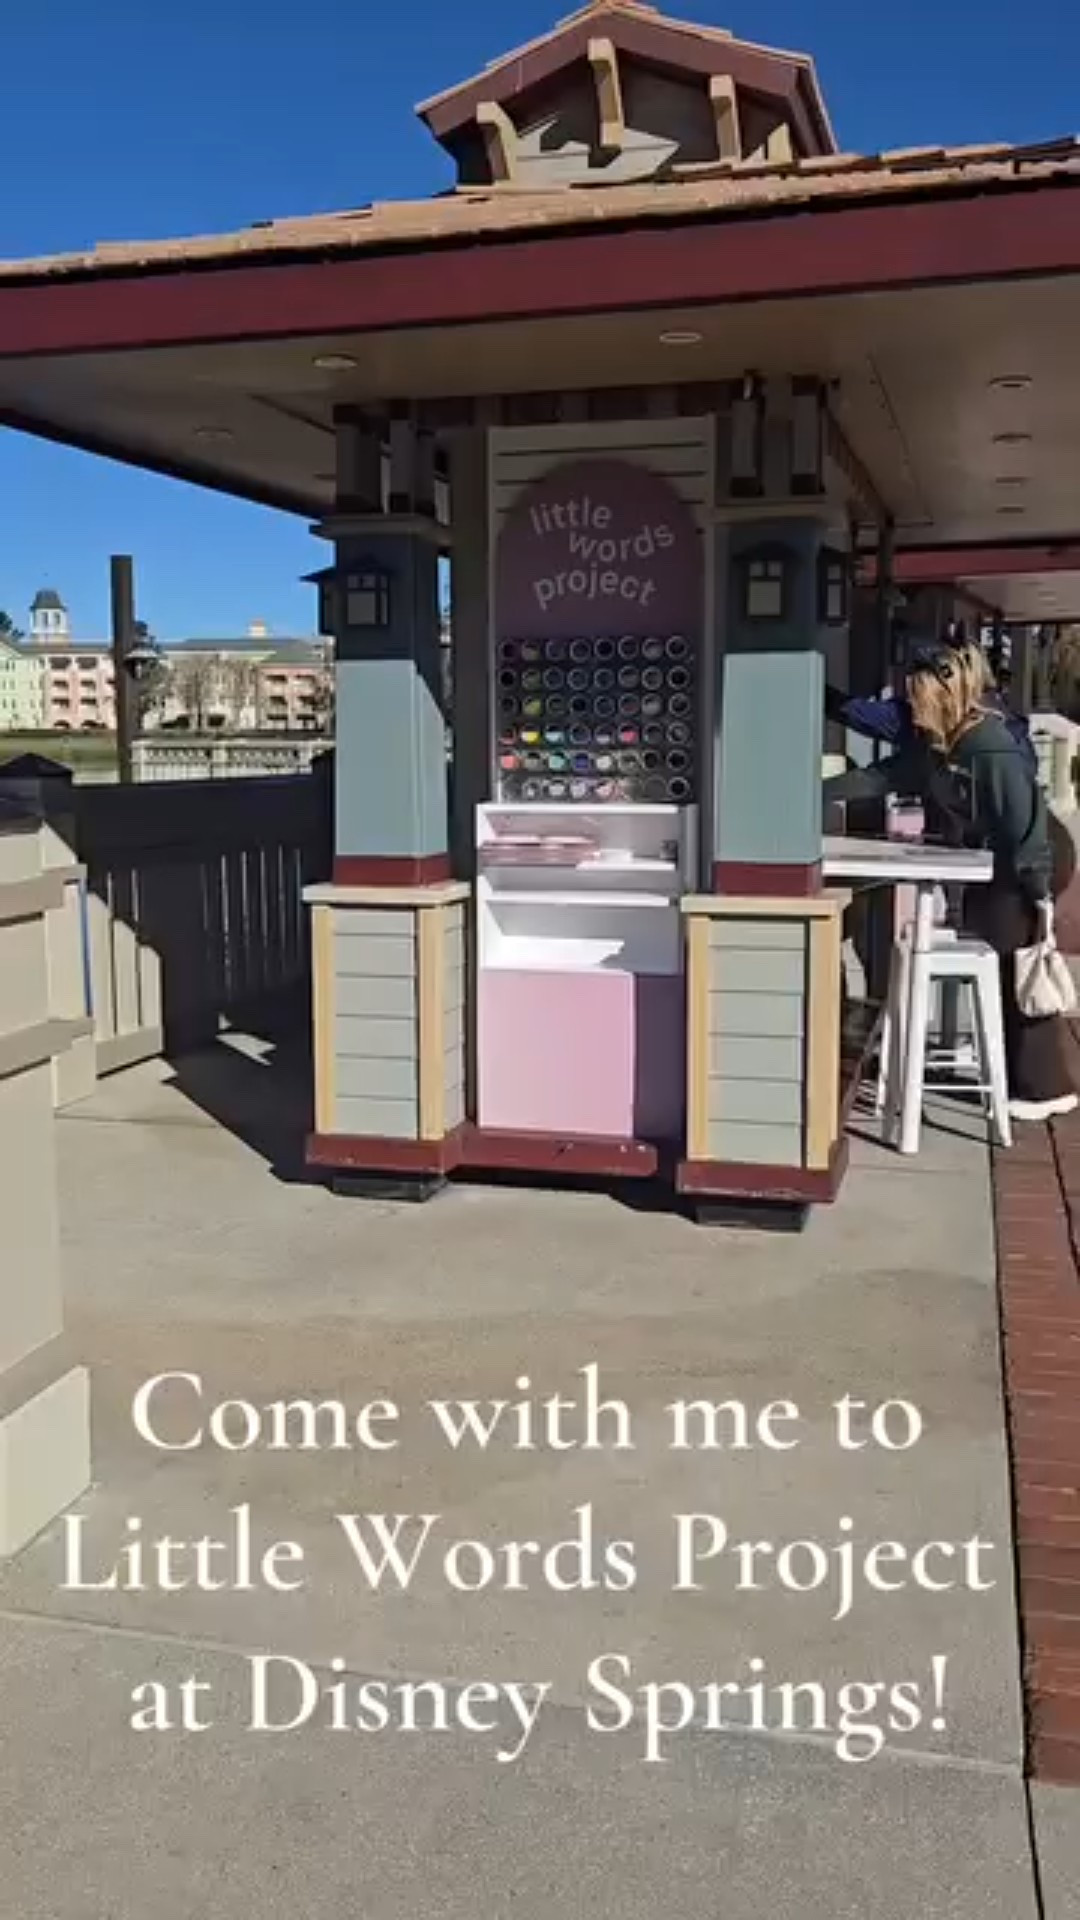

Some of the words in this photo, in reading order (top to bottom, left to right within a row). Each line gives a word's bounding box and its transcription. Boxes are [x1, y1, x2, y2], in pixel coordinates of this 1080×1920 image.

[530, 495, 613, 535] little
[568, 524, 675, 562] words
[533, 561, 657, 611] project
